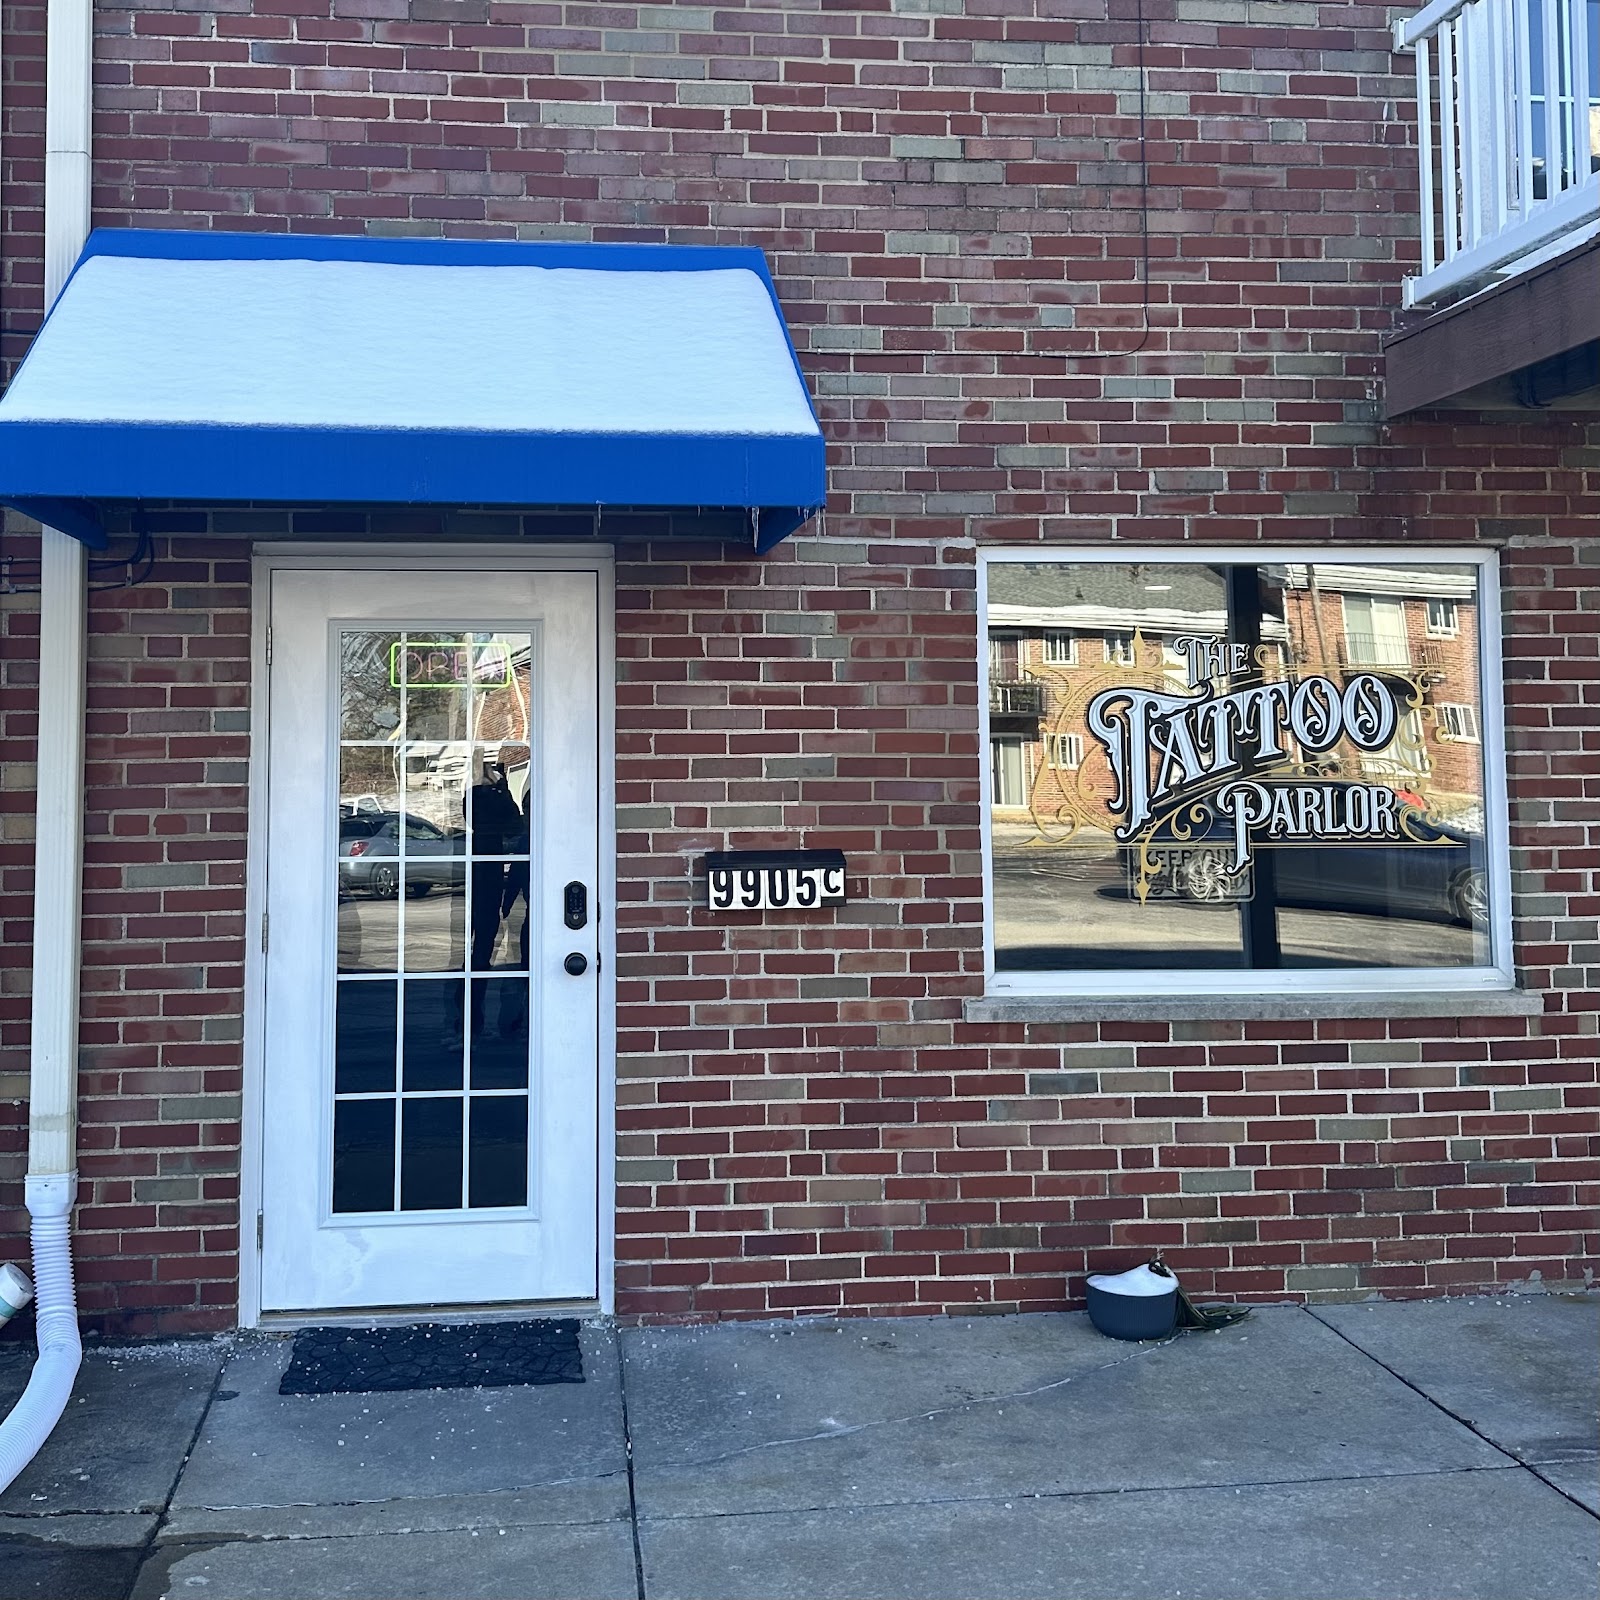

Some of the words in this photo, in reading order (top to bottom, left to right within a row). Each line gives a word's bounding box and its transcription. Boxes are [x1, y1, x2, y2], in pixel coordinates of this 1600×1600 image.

[1173, 636, 1251, 688] THE
[1086, 674, 1398, 842] TATTOO
[1217, 780, 1400, 877] PARLOR
